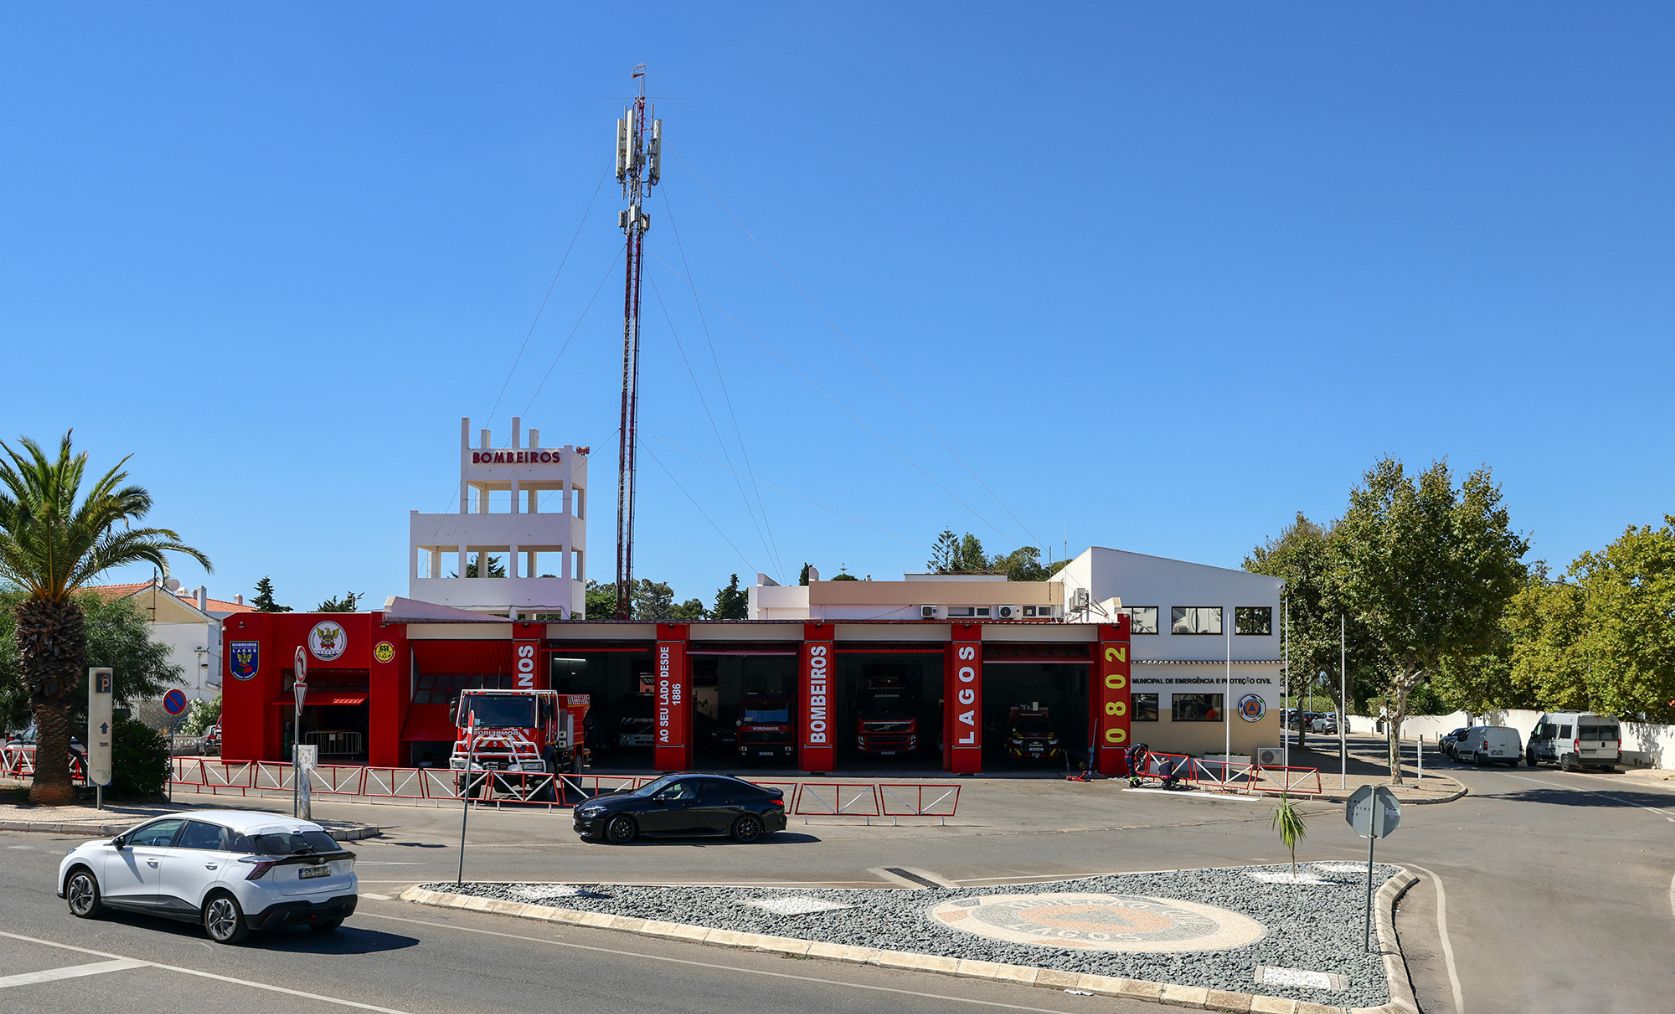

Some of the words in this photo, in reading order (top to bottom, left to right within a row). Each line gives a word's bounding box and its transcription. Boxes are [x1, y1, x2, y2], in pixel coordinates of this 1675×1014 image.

[472, 451, 561, 464] BOMBEIROS
[518, 645, 534, 691] NOS
[660, 646, 669, 678] DESDE
[660, 680, 669, 705] LADO
[1175, 676, 1214, 684] EMERGÊNCIA
[1222, 677, 1255, 685] POTEÇO
[672, 683, 681, 706] 1886
[810, 645, 827, 743] BOMBEIROS
[958, 646, 975, 744] LAGOS
[1105, 647, 1127, 743] 0802
[660, 708, 669, 727] SEU
[660, 729, 669, 743] AO
